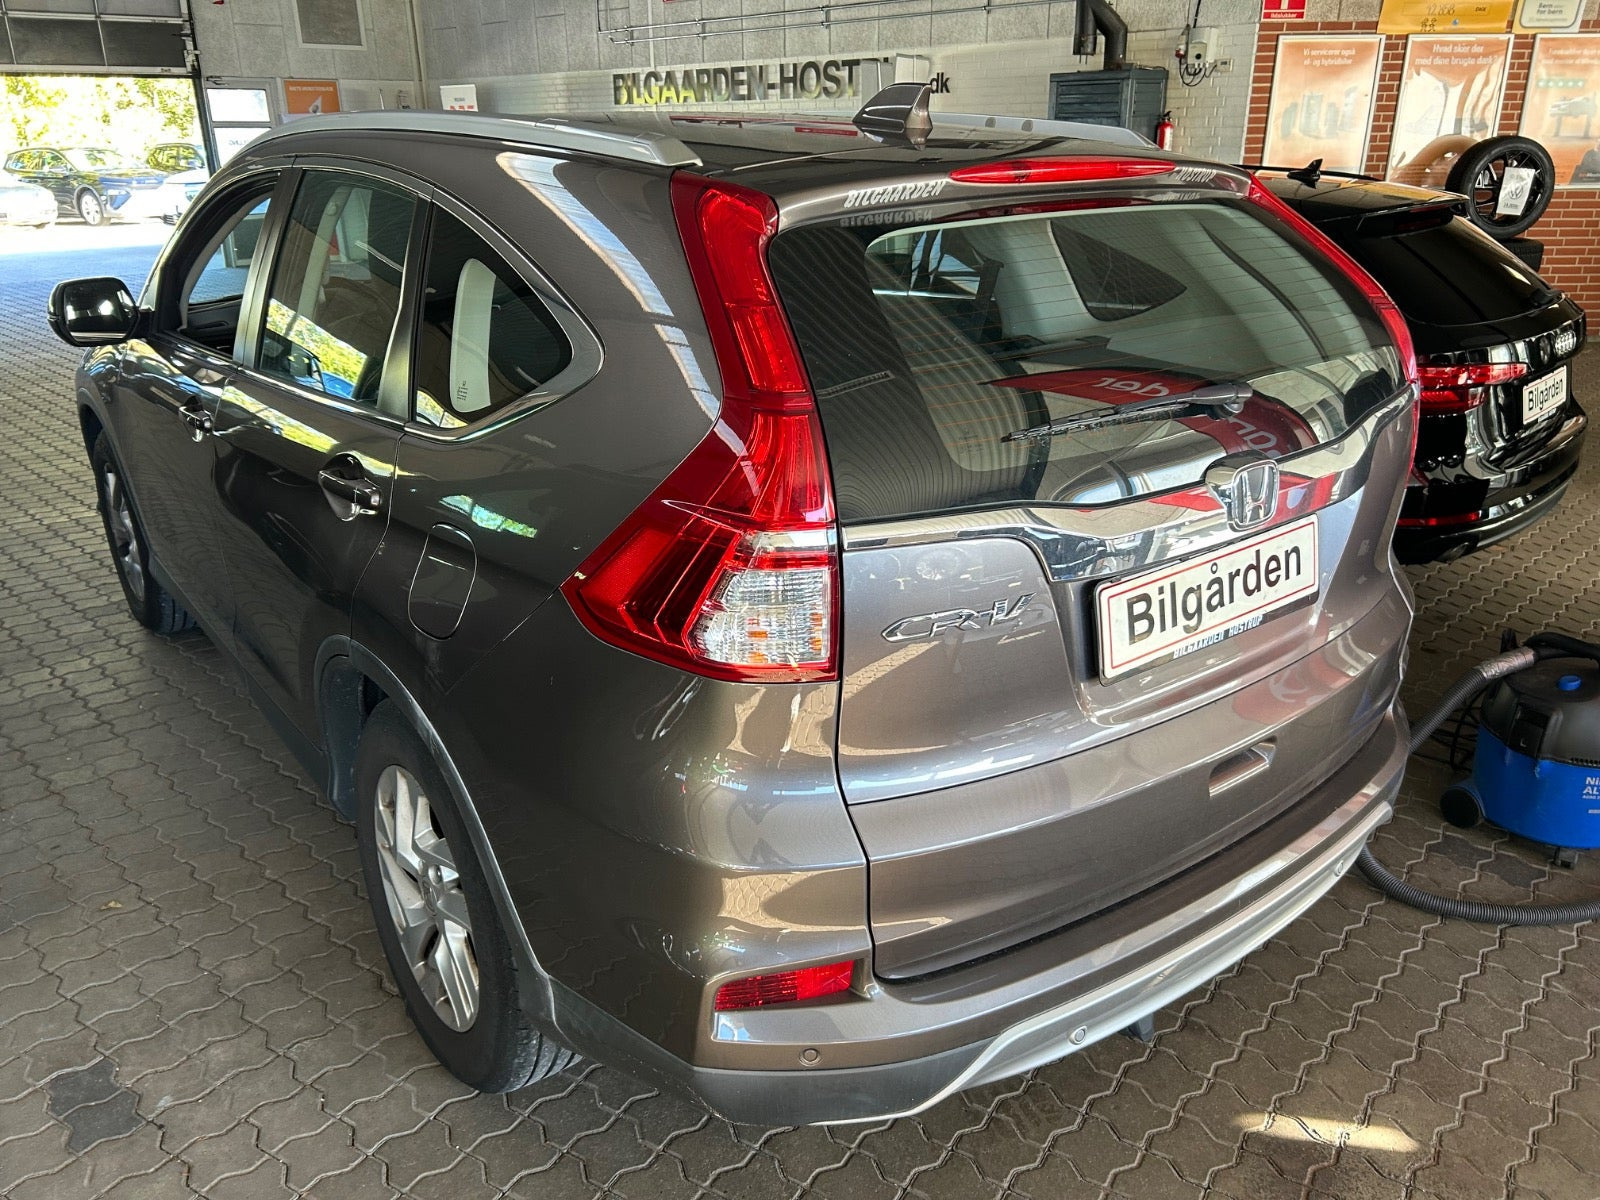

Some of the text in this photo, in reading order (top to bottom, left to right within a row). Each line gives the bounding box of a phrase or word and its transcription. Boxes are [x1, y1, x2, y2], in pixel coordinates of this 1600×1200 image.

[1303, 48, 1310, 56] Vi
[1415, 56, 1432, 65] med
[1433, 56, 1449, 65] dine
[1451, 55, 1476, 67] brugte
[1432, 44, 1453, 53] Hvad
[1471, 43, 1484, 53] der
[843, 180, 947, 208] BILGAARDEN
[1528, 378, 1563, 412] Bilgården
[1126, 545, 1302, 646] Bilgården
[880, 592, 1038, 644] CR-V
